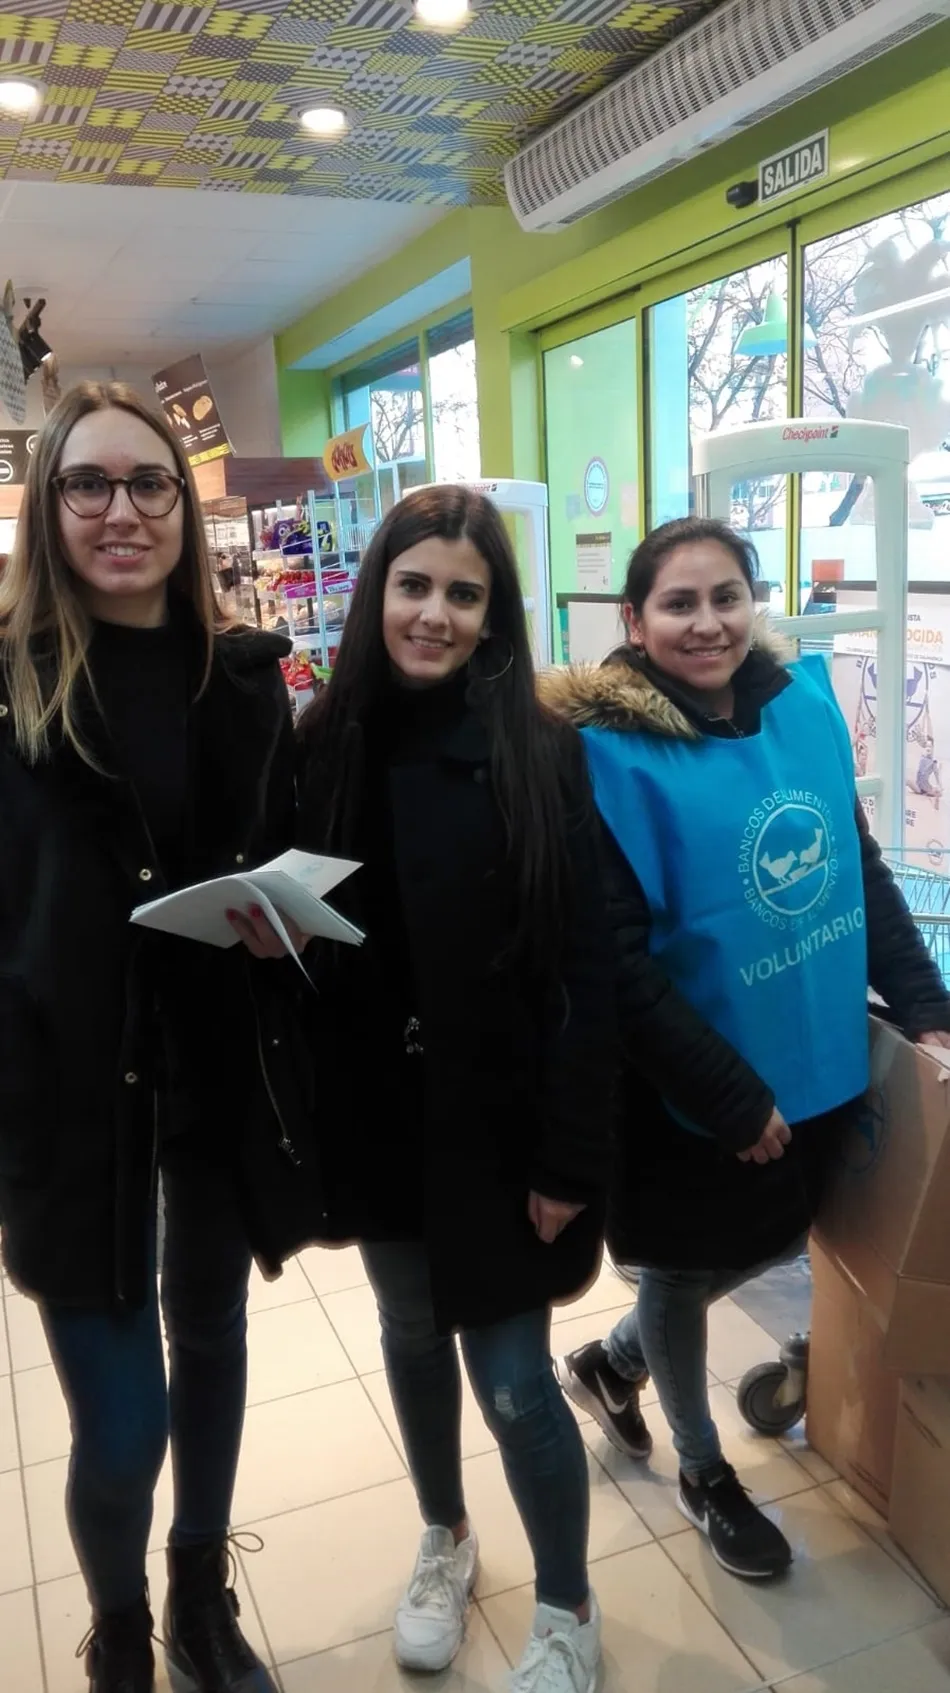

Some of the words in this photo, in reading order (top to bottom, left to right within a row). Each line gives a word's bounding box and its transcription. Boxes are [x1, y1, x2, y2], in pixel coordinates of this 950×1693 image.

[764, 142, 822, 196] SALIDA
[782, 426, 829, 444] Checkpoint
[907, 628, 943, 644] OGIDA
[738, 807, 765, 873] BANCOS
[762, 790, 783, 811] DE
[743, 887, 787, 931] BANCOS
[739, 906, 864, 987] VOLUNTARIO
